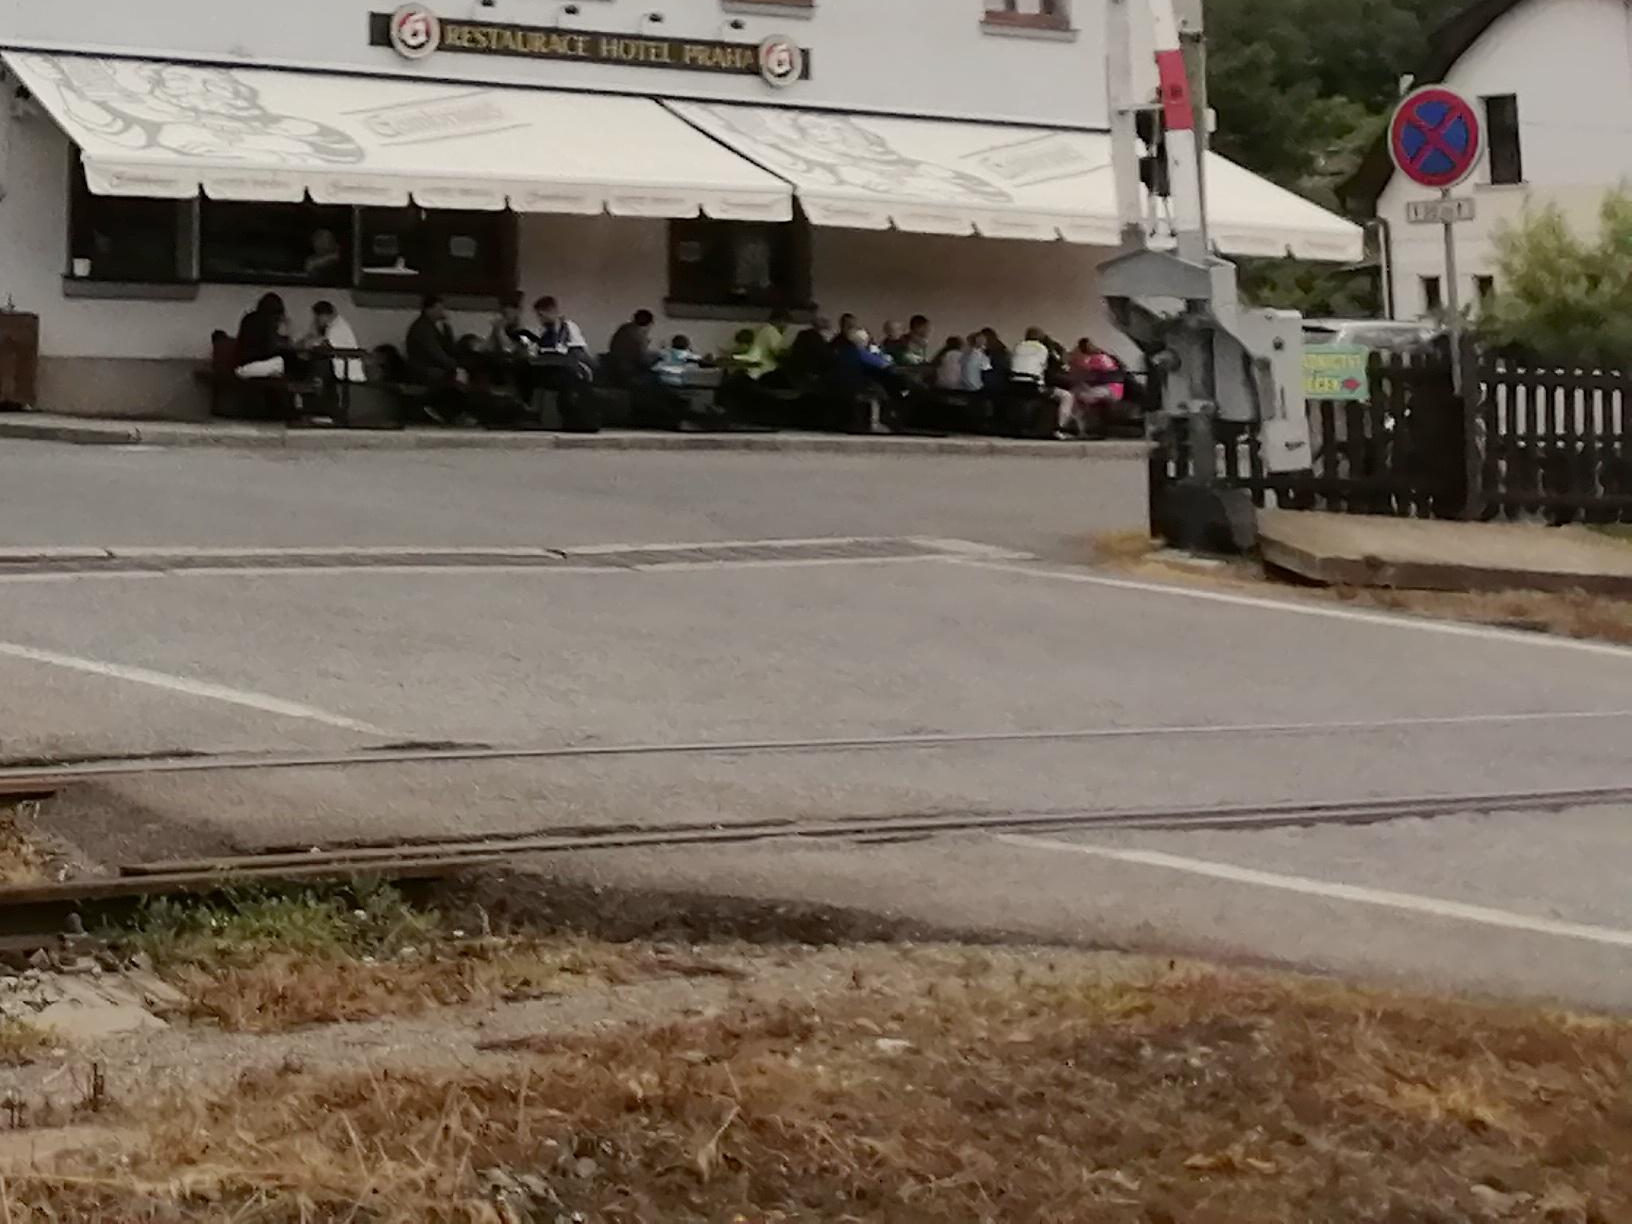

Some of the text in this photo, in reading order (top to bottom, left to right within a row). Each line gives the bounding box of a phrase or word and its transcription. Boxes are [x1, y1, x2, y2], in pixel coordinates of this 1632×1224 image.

[445, 25, 755, 69] RESTAURACE HOTEL PRAHA
